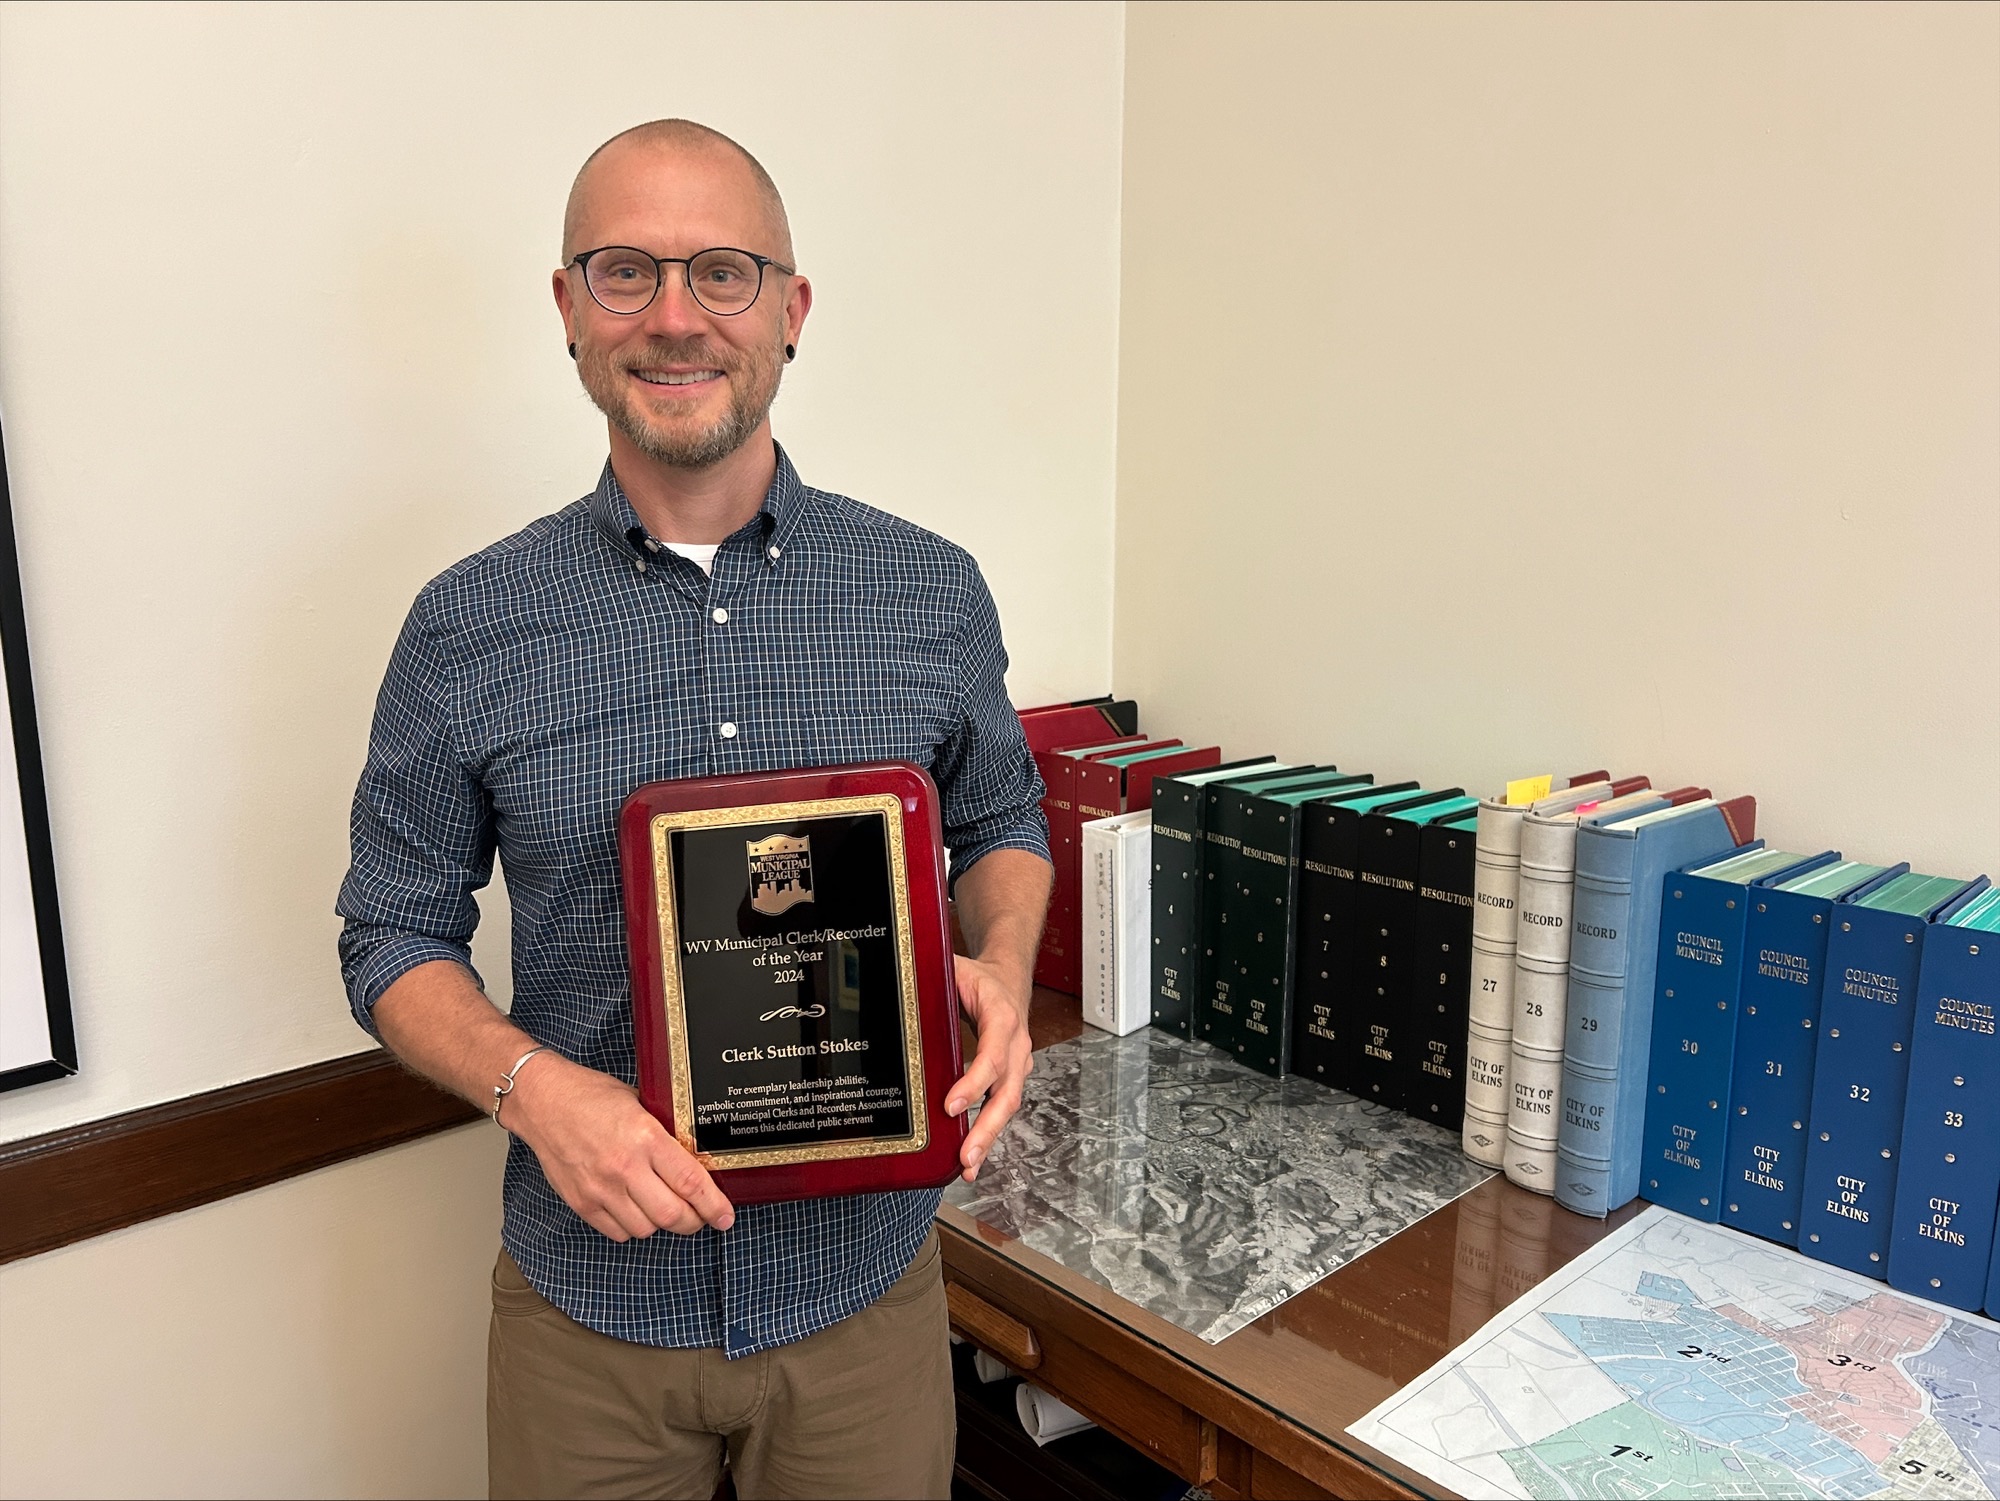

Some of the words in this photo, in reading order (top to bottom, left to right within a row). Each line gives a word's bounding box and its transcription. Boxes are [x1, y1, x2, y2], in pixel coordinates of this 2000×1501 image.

[1078, 804, 1115, 818] ORDINANCES
[1153, 823, 1192, 843] RESOLUTIONS
[1206, 832, 1241, 850] RESOLUTIO
[1242, 846, 1287, 866] RESOLUTIONS
[750, 859, 811, 874] MUNICIPAL
[1304, 860, 1355, 880] RESOLUTIONS
[762, 869, 801, 882] LEAGUE
[1361, 872, 1415, 892] RESOLUTIONS
[1420, 886, 1475, 908] RESOLUTION
[1477, 891, 1514, 910] RECORD
[1168, 904, 1174, 915] 4
[1221, 913, 1227, 924] 5
[1523, 911, 1563, 928] RECORD
[1257, 932, 1263, 943] 6
[1576, 922, 1617, 940] RECORD
[685, 939, 712, 955] WV
[714, 932, 784, 952] Municipal
[786, 925, 887, 945] Clerk/Recorder
[1323, 940, 1329, 951] 7
[1677, 931, 1723, 952] COUNCIL
[752, 953, 767, 967] of
[769, 952, 792, 966] the
[795, 950, 824, 963] Year
[1380, 955, 1387, 967] 8
[1675, 945, 1723, 966] MINUTES
[1759, 949, 1810, 970] COUNCIL
[774, 969, 805, 984] 2024
[1164, 967, 1178, 980] CITY
[1440, 973, 1447, 985] 9
[1757, 963, 1809, 985] MINUTES
[1844, 968, 1899, 990] COUNCIL
[1166, 978, 1175, 988] OF
[1216, 980, 1229, 993] CITY
[1482, 978, 1497, 992] 27
[1160, 985, 1181, 1001] ELKINS
[1218, 991, 1227, 1002] OF
[1842, 982, 1898, 1005] MINUTES
[1212, 999, 1233, 1015] ELKINS
[1250, 999, 1266, 1013] CITY
[1313, 1004, 1331, 1017] CITY
[1526, 1002, 1543, 1017] 28
[1939, 997, 1995, 1019] COUNCIL
[1253, 1011, 1262, 1022] OF
[1317, 1016, 1327, 1027] OF
[1581, 1017, 1598, 1032] 29
[1934, 1012, 1996, 1035] MINUTES
[1245, 1018, 1269, 1035] ELKINS
[1308, 1023, 1335, 1041] ELKINS
[1370, 1024, 1389, 1038] CITY
[1373, 1036, 1384, 1047] OF
[1428, 1040, 1447, 1055] CITY
[1681, 1039, 1698, 1055] 30
[721, 1047, 765, 1063] Clerk
[767, 1044, 817, 1059] Sutton
[820, 1038, 870, 1054] Stokes
[1364, 1044, 1393, 1062] ELKINS
[1433, 1053, 1444, 1065] OF
[1422, 1060, 1452, 1079] ELKINS
[1470, 1056, 1488, 1072] CITY
[1490, 1063, 1505, 1075] OF
[1765, 1060, 1783, 1077] 31
[727, 1086, 742, 1097] For
[743, 1083, 788, 1096] exemplary
[789, 1076, 833, 1091] leadership
[834, 1075, 870, 1087] abilities,
[1471, 1070, 1503, 1089] ELKINS
[1515, 1083, 1535, 1098] CITY
[1538, 1089, 1554, 1100] OF
[1849, 1084, 1871, 1102] 32
[697, 1100, 735, 1116] symbolic
[736, 1095, 793, 1110] commitment,
[793, 1093, 810, 1104] and
[811, 1087, 864, 1104] inspirational
[865, 1086, 902, 1099] courage,
[1515, 1097, 1551, 1115] ELKINS
[1566, 1097, 1587, 1114] CITY
[1589, 1105, 1605, 1117] OF
[698, 1115, 712, 1125] the
[713, 1112, 728, 1124] WV
[729, 1109, 771, 1123] Municipal
[772, 1107, 798, 1119] Clerks
[799, 1105, 815, 1116] and
[816, 1101, 857, 1114] Recorders
[857, 1097, 904, 1112] Association
[1944, 1111, 1963, 1128] 33
[730, 1124, 760, 1136] honors
[759, 1122, 776, 1133] this
[776, 1119, 816, 1132] dedicated
[817, 1116, 843, 1130] public
[843, 1113, 874, 1126] servant
[1565, 1111, 1600, 1132] ELKINS
[1672, 1125, 1697, 1141] CITY
[1675, 1139, 1691, 1151] OF
[1753, 1145, 1780, 1162] CITY
[1664, 1149, 1701, 1170] ELKINS
[1758, 1160, 1774, 1174] OF
[1744, 1169, 1784, 1192] ELKINS
[1836, 1175, 1866, 1193] CITY
[1841, 1190, 1858, 1205] OF
[1929, 1197, 1960, 1215] CITY
[1826, 1199, 1869, 1224] ELKINS
[1932, 1213, 1951, 1228] OF
[1919, 1223, 1965, 1247] ELKINS
[1676, 1345, 1732, 1364] 2nd
[1827, 1354, 1877, 1372] 3rd
[1609, 1444, 1654, 1462] 1st
